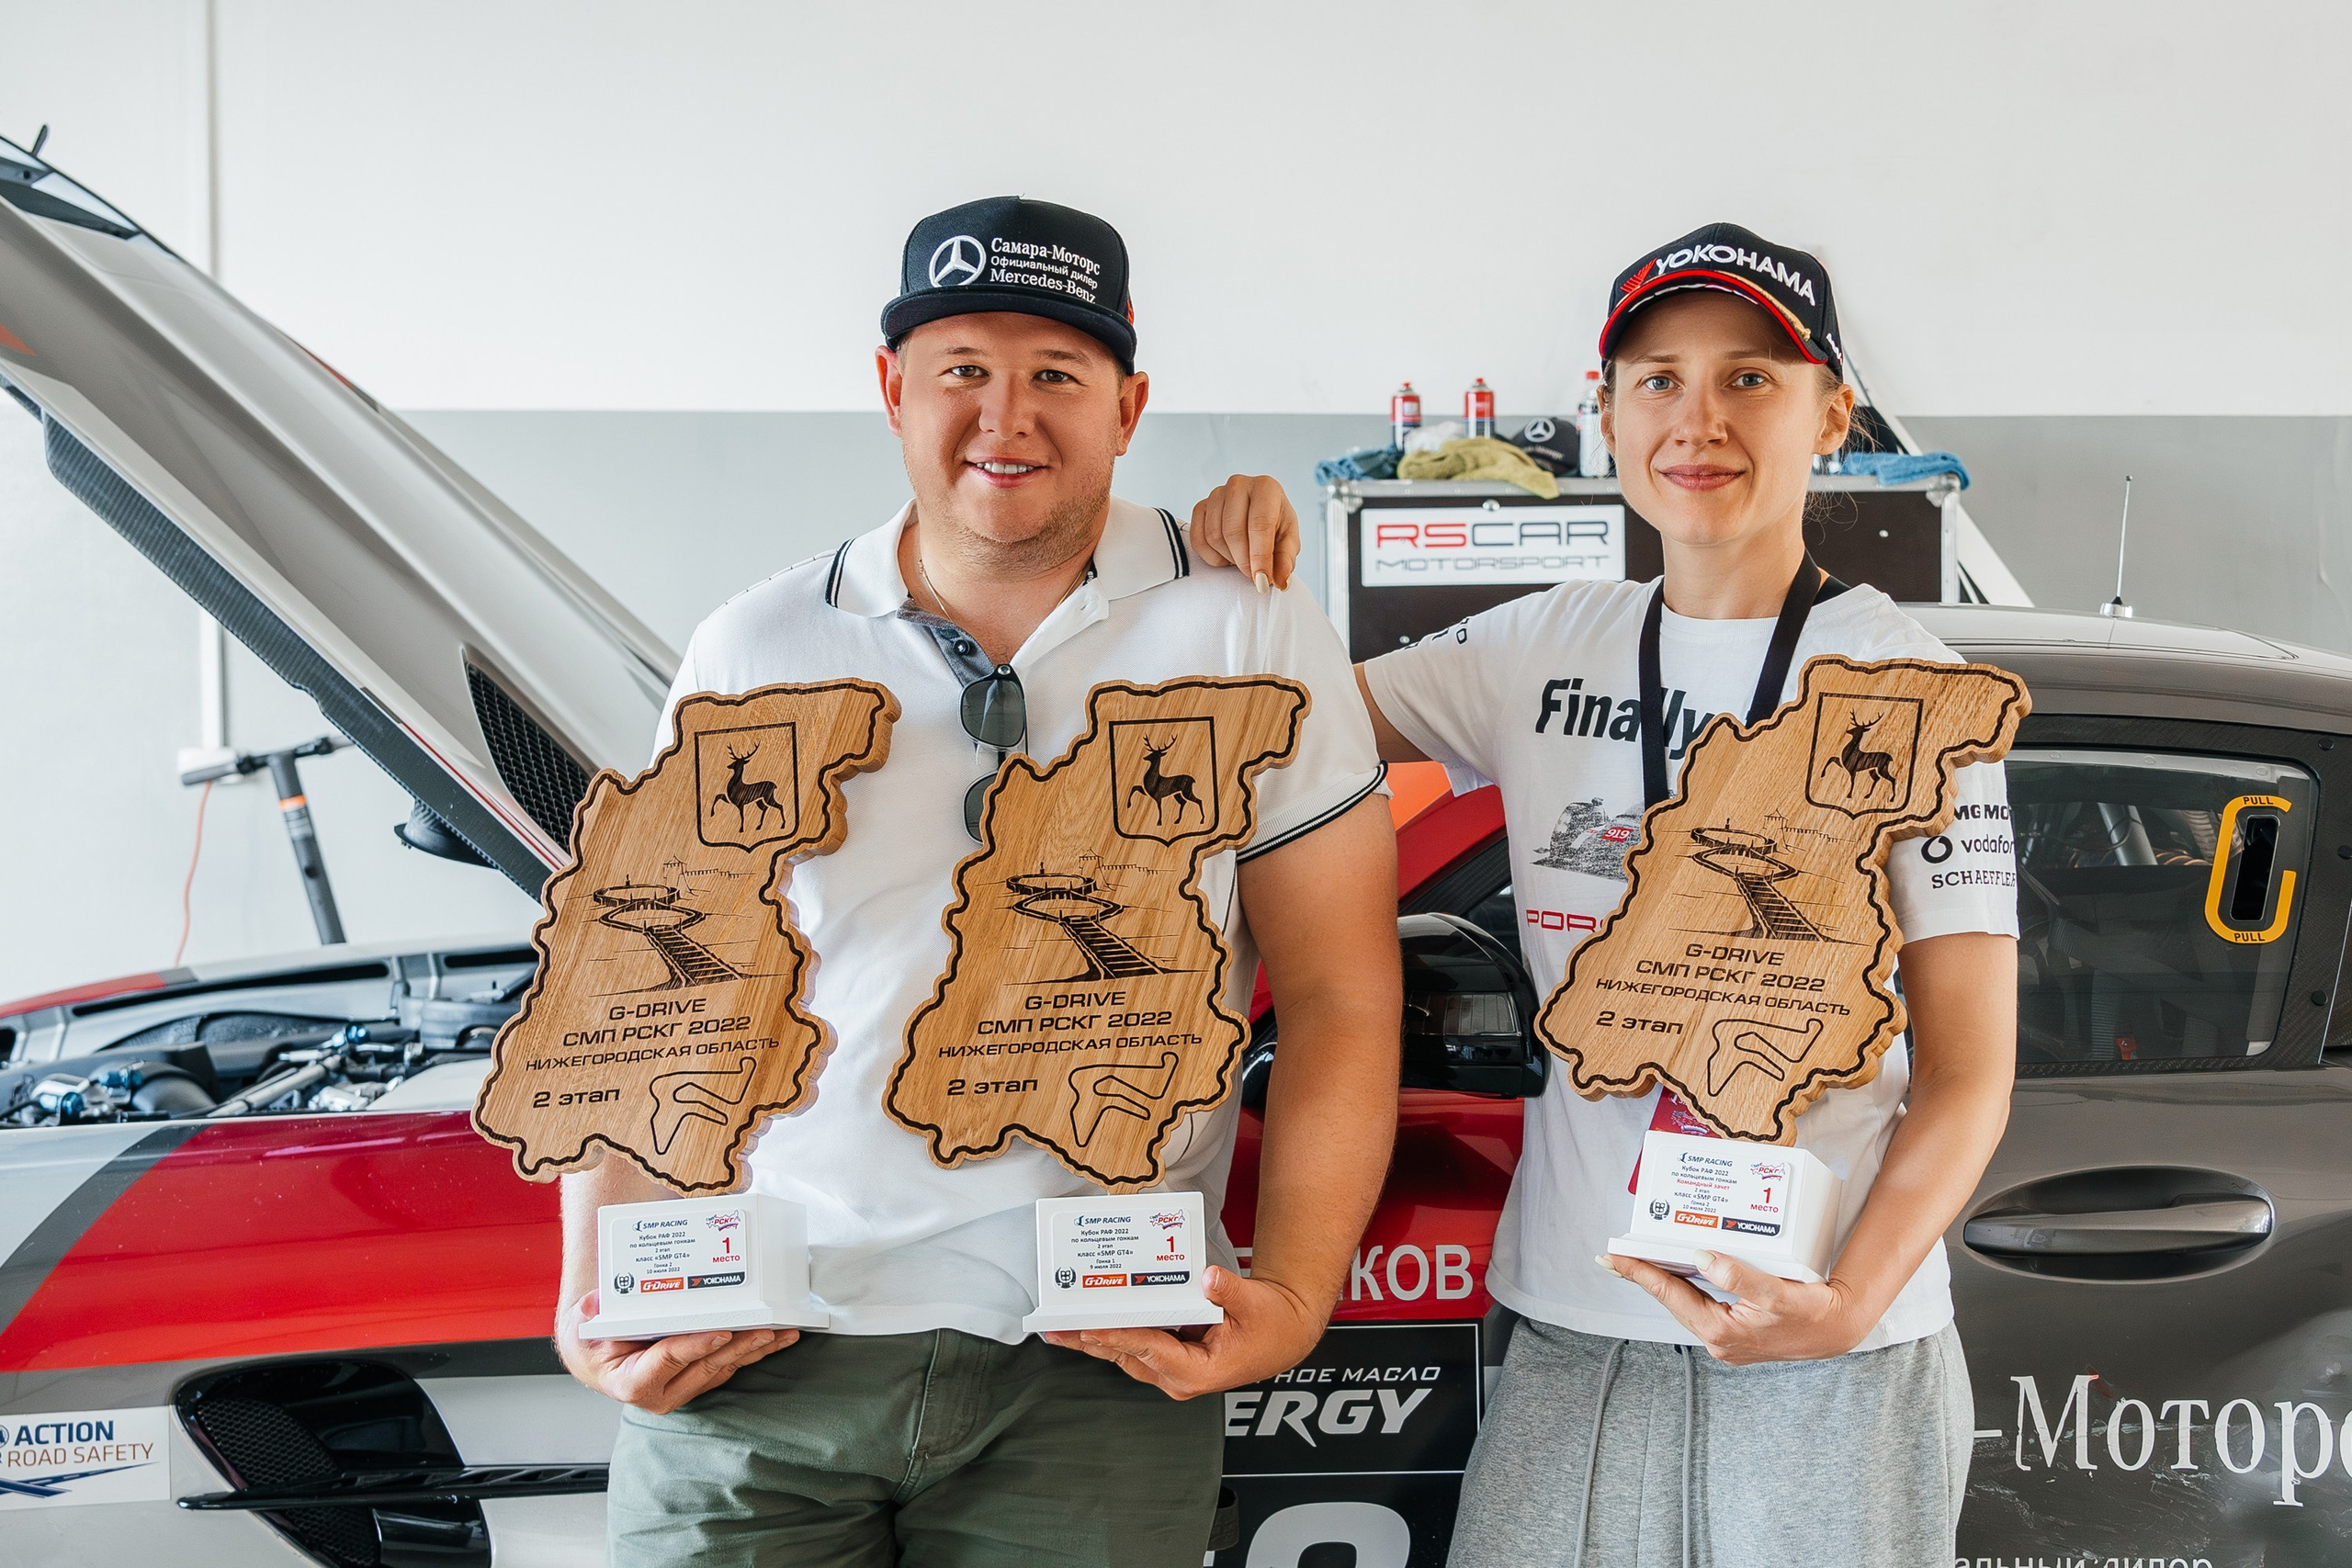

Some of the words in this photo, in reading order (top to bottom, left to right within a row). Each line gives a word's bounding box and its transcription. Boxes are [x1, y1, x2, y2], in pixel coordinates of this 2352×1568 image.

[991, 237, 1101, 276] Самара-Моторс
[990, 256, 1069, 276] Официальный
[1070, 270, 1098, 290] дилер
[1656, 243, 1815, 306] YOKOHAMA
[989, 268, 1096, 304] Mercedes-Benz
[1376, 520, 1609, 548] RSCAR
[1376, 555, 1610, 571] MOTORSPORT
[2243, 795, 2274, 806] PULL
[1605, 829, 1630, 839] 919
[1526, 908, 1603, 933] POR
[2233, 931, 2266, 942] PULL
[1685, 943, 1785, 966] G-DRIVE
[1636, 960, 1690, 977] СМП
[1695, 964, 1756, 984] РСКГ
[1762, 973, 1826, 992] 2022
[1024, 991, 1126, 1010] G-DRIVE
[1596, 978, 1761, 1006] НИЖЕГОРОДСКАЯ
[1764, 997, 1850, 1016] ОБЛАСТЬ
[609, 998, 707, 1021] G-DRIVE
[978, 1019, 1033, 1035] СМП
[1039, 1015, 1102, 1032] РСКГ
[1107, 1011, 1172, 1028] 2022
[1596, 1010, 1615, 1027] 2
[1622, 1016, 1683, 1034] этап
[562, 1029, 616, 1047] СМП
[622, 1022, 682, 1042] РСКГ
[689, 1016, 751, 1035] 2022
[938, 1039, 1111, 1058] НИЖЕГОРОДСКАЯ
[1116, 1033, 1202, 1049] ОБЛАСТЬ
[526, 1046, 690, 1071] НИЖЕГОРОДСКАЯ
[695, 1038, 779, 1055] ОБЛАСТЬ
[946, 1079, 966, 1096] 2
[974, 1079, 1038, 1094] этап
[533, 1090, 550, 1109] 2
[559, 1088, 619, 1107] этап
[1687, 1156, 1704, 1164] SMP
[1705, 1157, 1733, 1168] RACING
[1677, 1179, 1713, 1189] Командный
[1680, 1173, 1714, 1181] кольцевым
[1763, 1187, 1771, 1203] 1
[1750, 1204, 1779, 1213] место
[643, 1221, 660, 1230] SMP
[660, 1220, 688, 1228] RACING
[1102, 1216, 1132, 1224] RACING
[1737, 1222, 1776, 1235] YOKOHAMA
[639, 1241, 673, 1249] кольцевым
[722, 1237, 729, 1254] 1
[1080, 1236, 1116, 1245] кольцевым
[1167, 1236, 1175, 1252] 1
[713, 1255, 741, 1263] место
[1156, 1254, 1185, 1262] место
[703, 1275, 741, 1285] YOKOHAMA
[1147, 1273, 1186, 1282] YOKOHAMA
[14, 1420, 114, 1447] ACTION
[7, 1448, 66, 1468] ROAD
[74, 1442, 153, 1463] SAFETY
